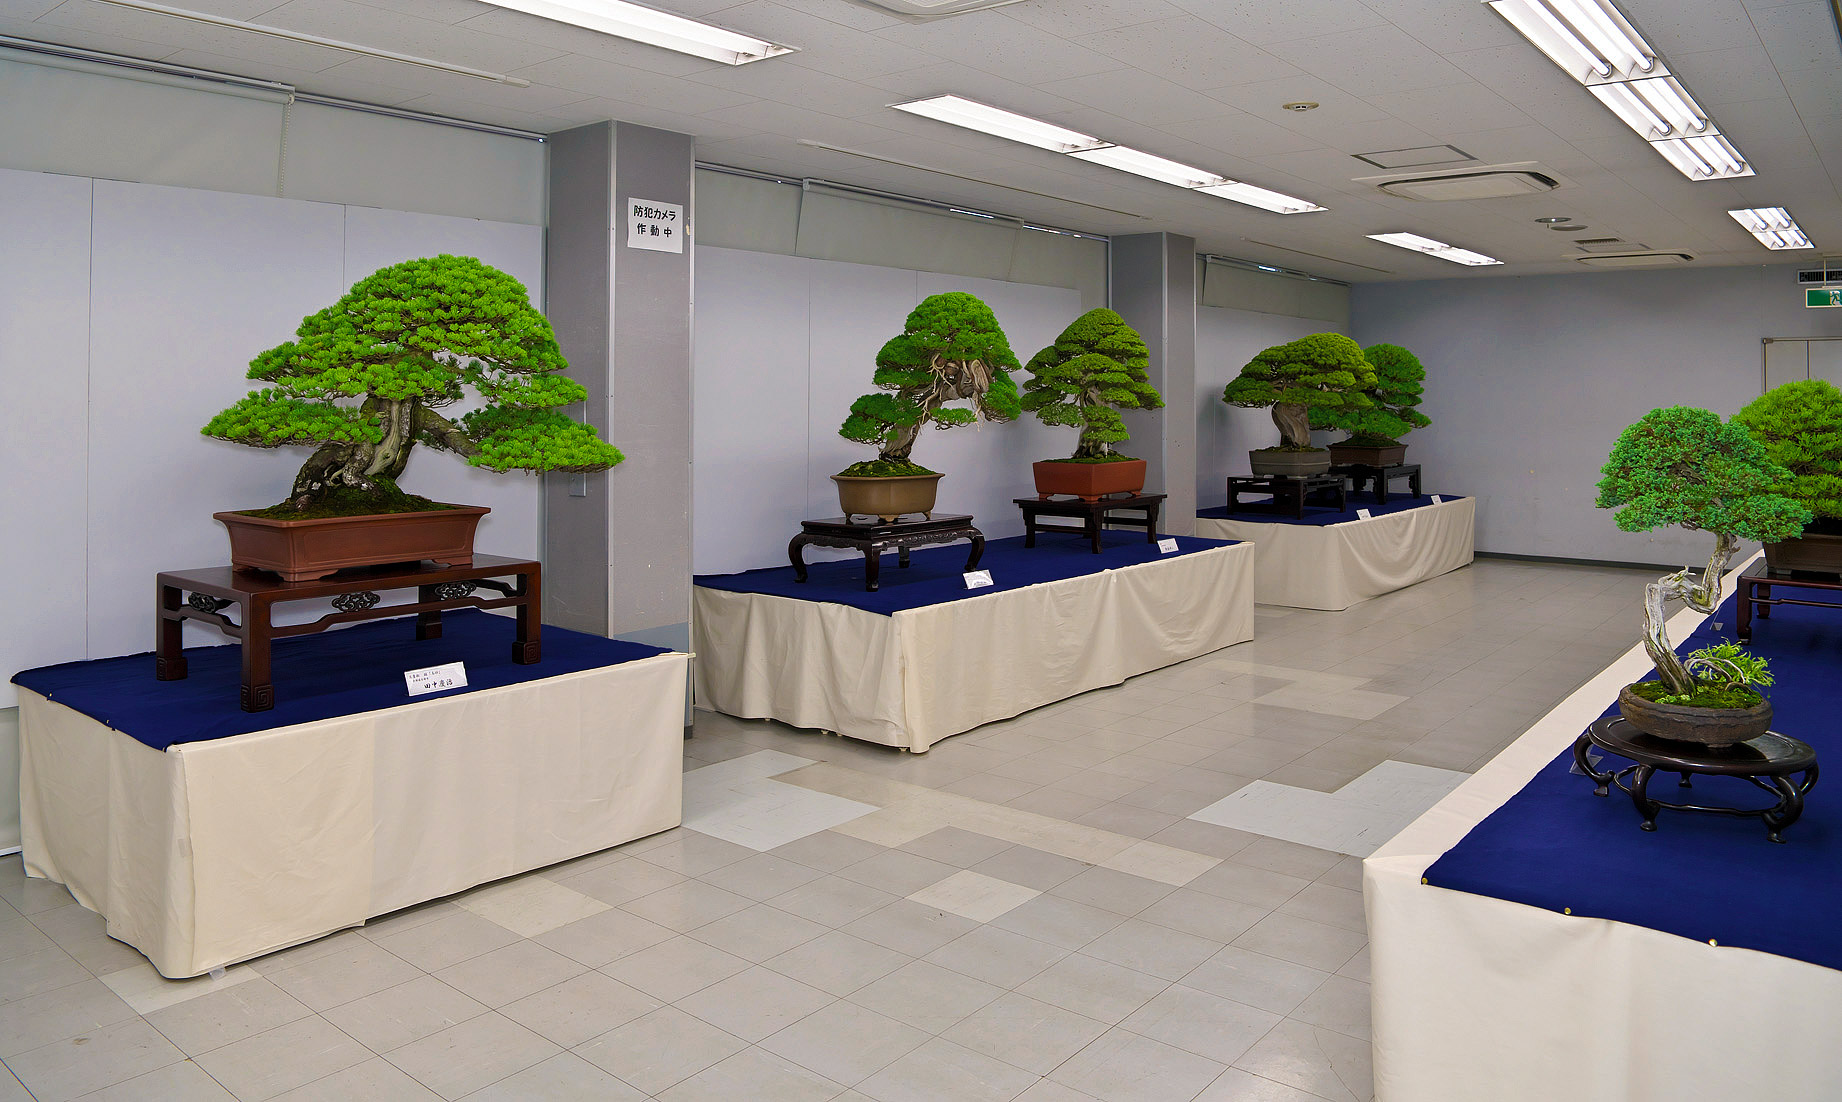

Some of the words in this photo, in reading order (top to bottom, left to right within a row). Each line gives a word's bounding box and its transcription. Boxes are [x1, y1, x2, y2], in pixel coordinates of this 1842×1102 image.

[633, 205, 676, 221] 防犯カメラ
